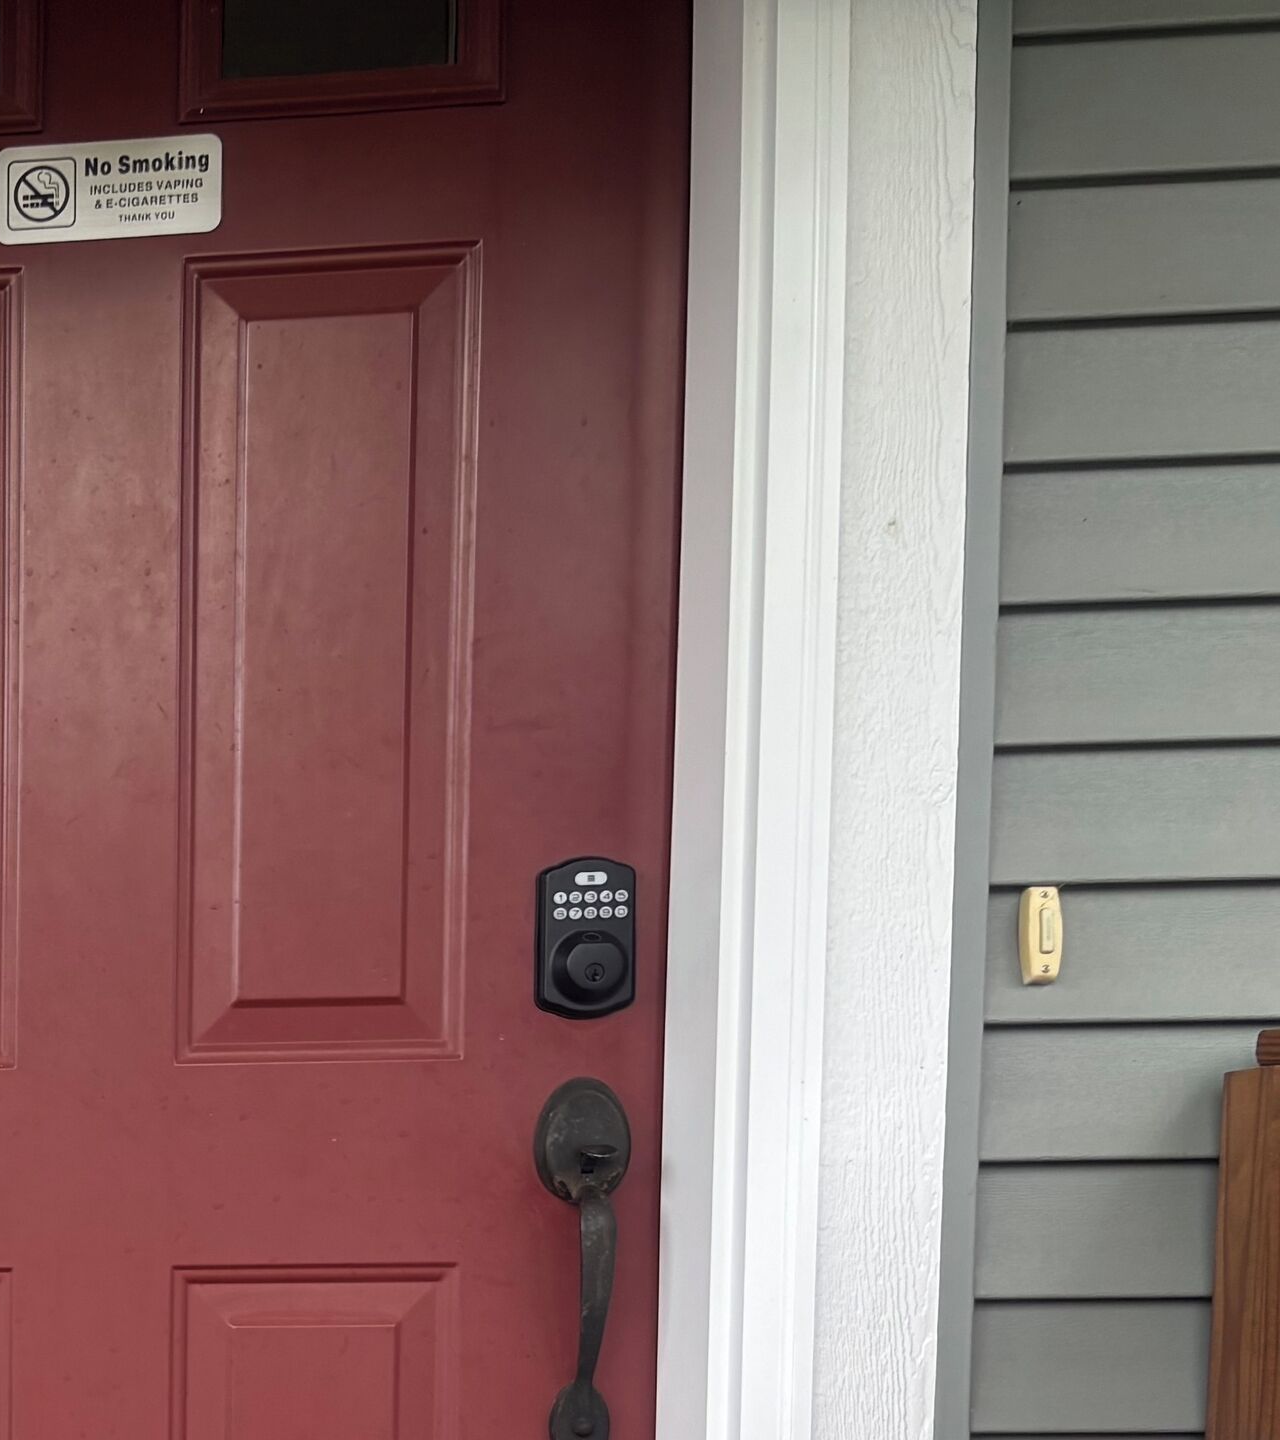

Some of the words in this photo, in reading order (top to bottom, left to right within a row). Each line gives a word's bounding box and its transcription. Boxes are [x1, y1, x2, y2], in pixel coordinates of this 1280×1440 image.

[84, 157, 112, 177] No
[118, 151, 209, 174] Smoking
[90, 180, 153, 196] INCLUDES
[156, 177, 203, 192] VAPING
[94, 199, 103, 209] &
[106, 192, 199, 209] E-CIGARETTES
[118, 213, 152, 222] THANK
[154, 211, 175, 221] YOU
